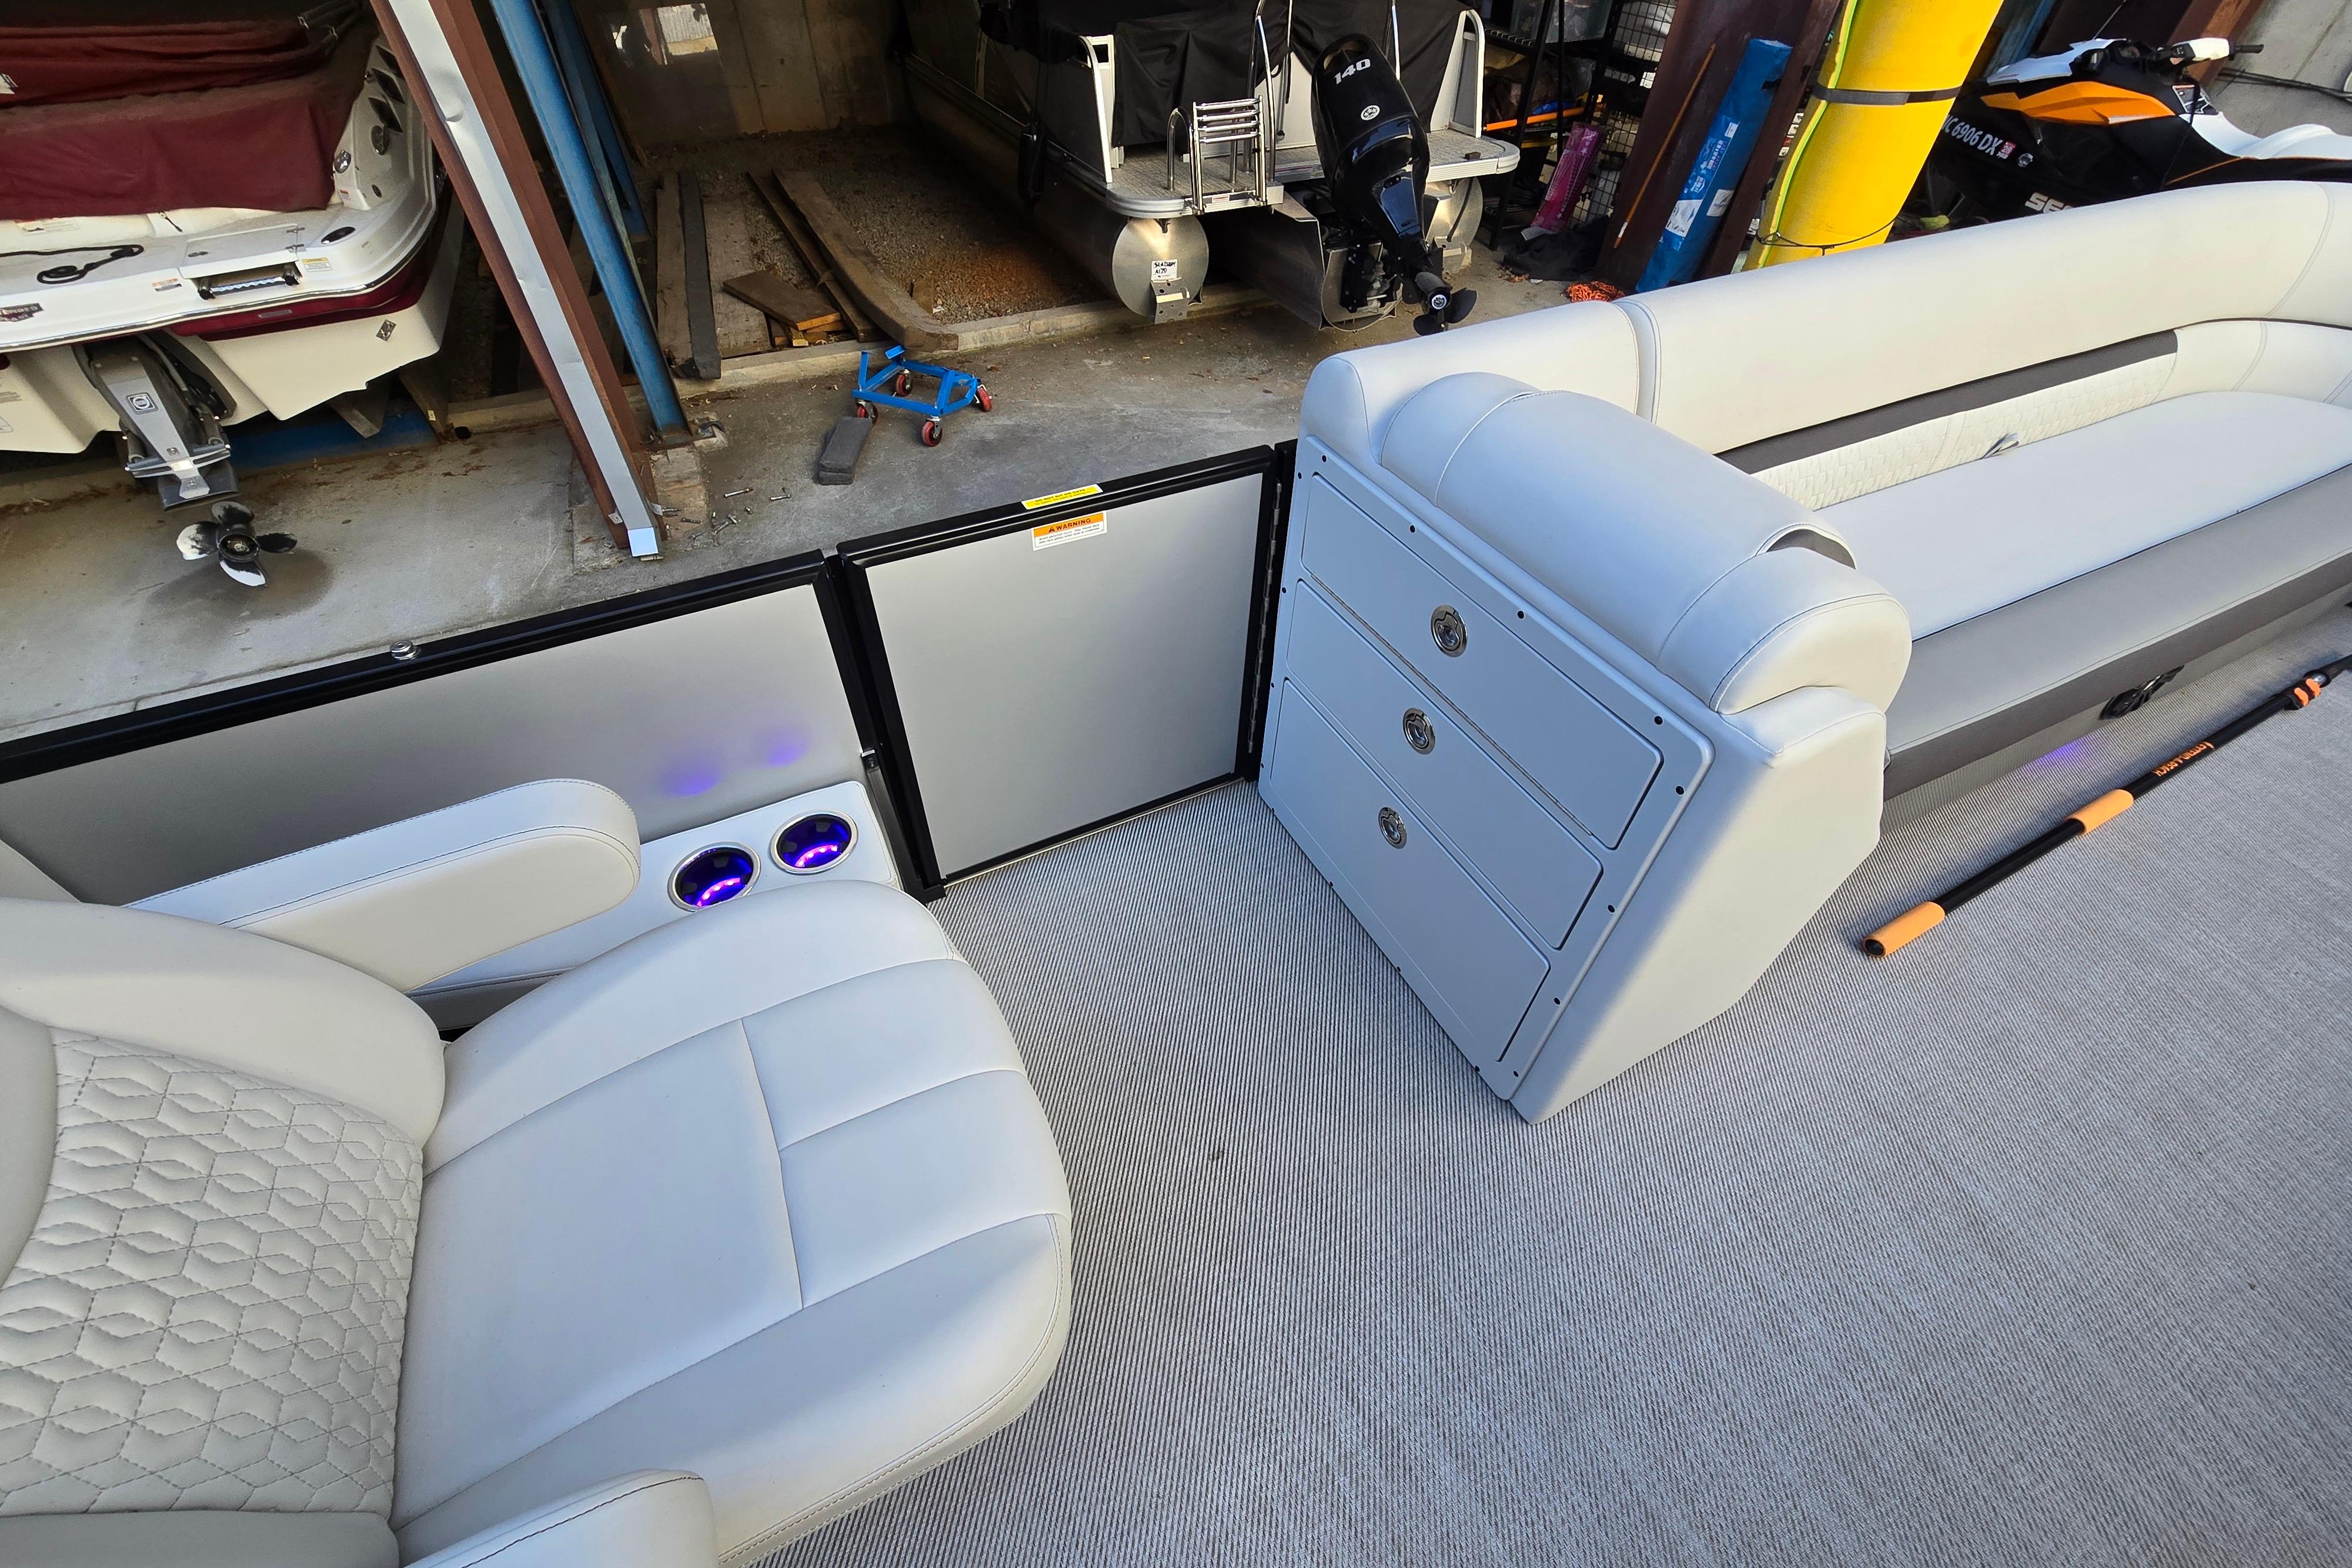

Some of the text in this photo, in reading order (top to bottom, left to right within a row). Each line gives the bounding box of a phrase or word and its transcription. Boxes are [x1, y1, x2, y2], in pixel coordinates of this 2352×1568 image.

[1334, 59, 1371, 84] 140
[1951, 122, 1983, 146] 6906
[1977, 133, 2003, 156] DX
[2001, 145, 2013, 155] 28
[1056, 518, 1091, 532] WARNING
